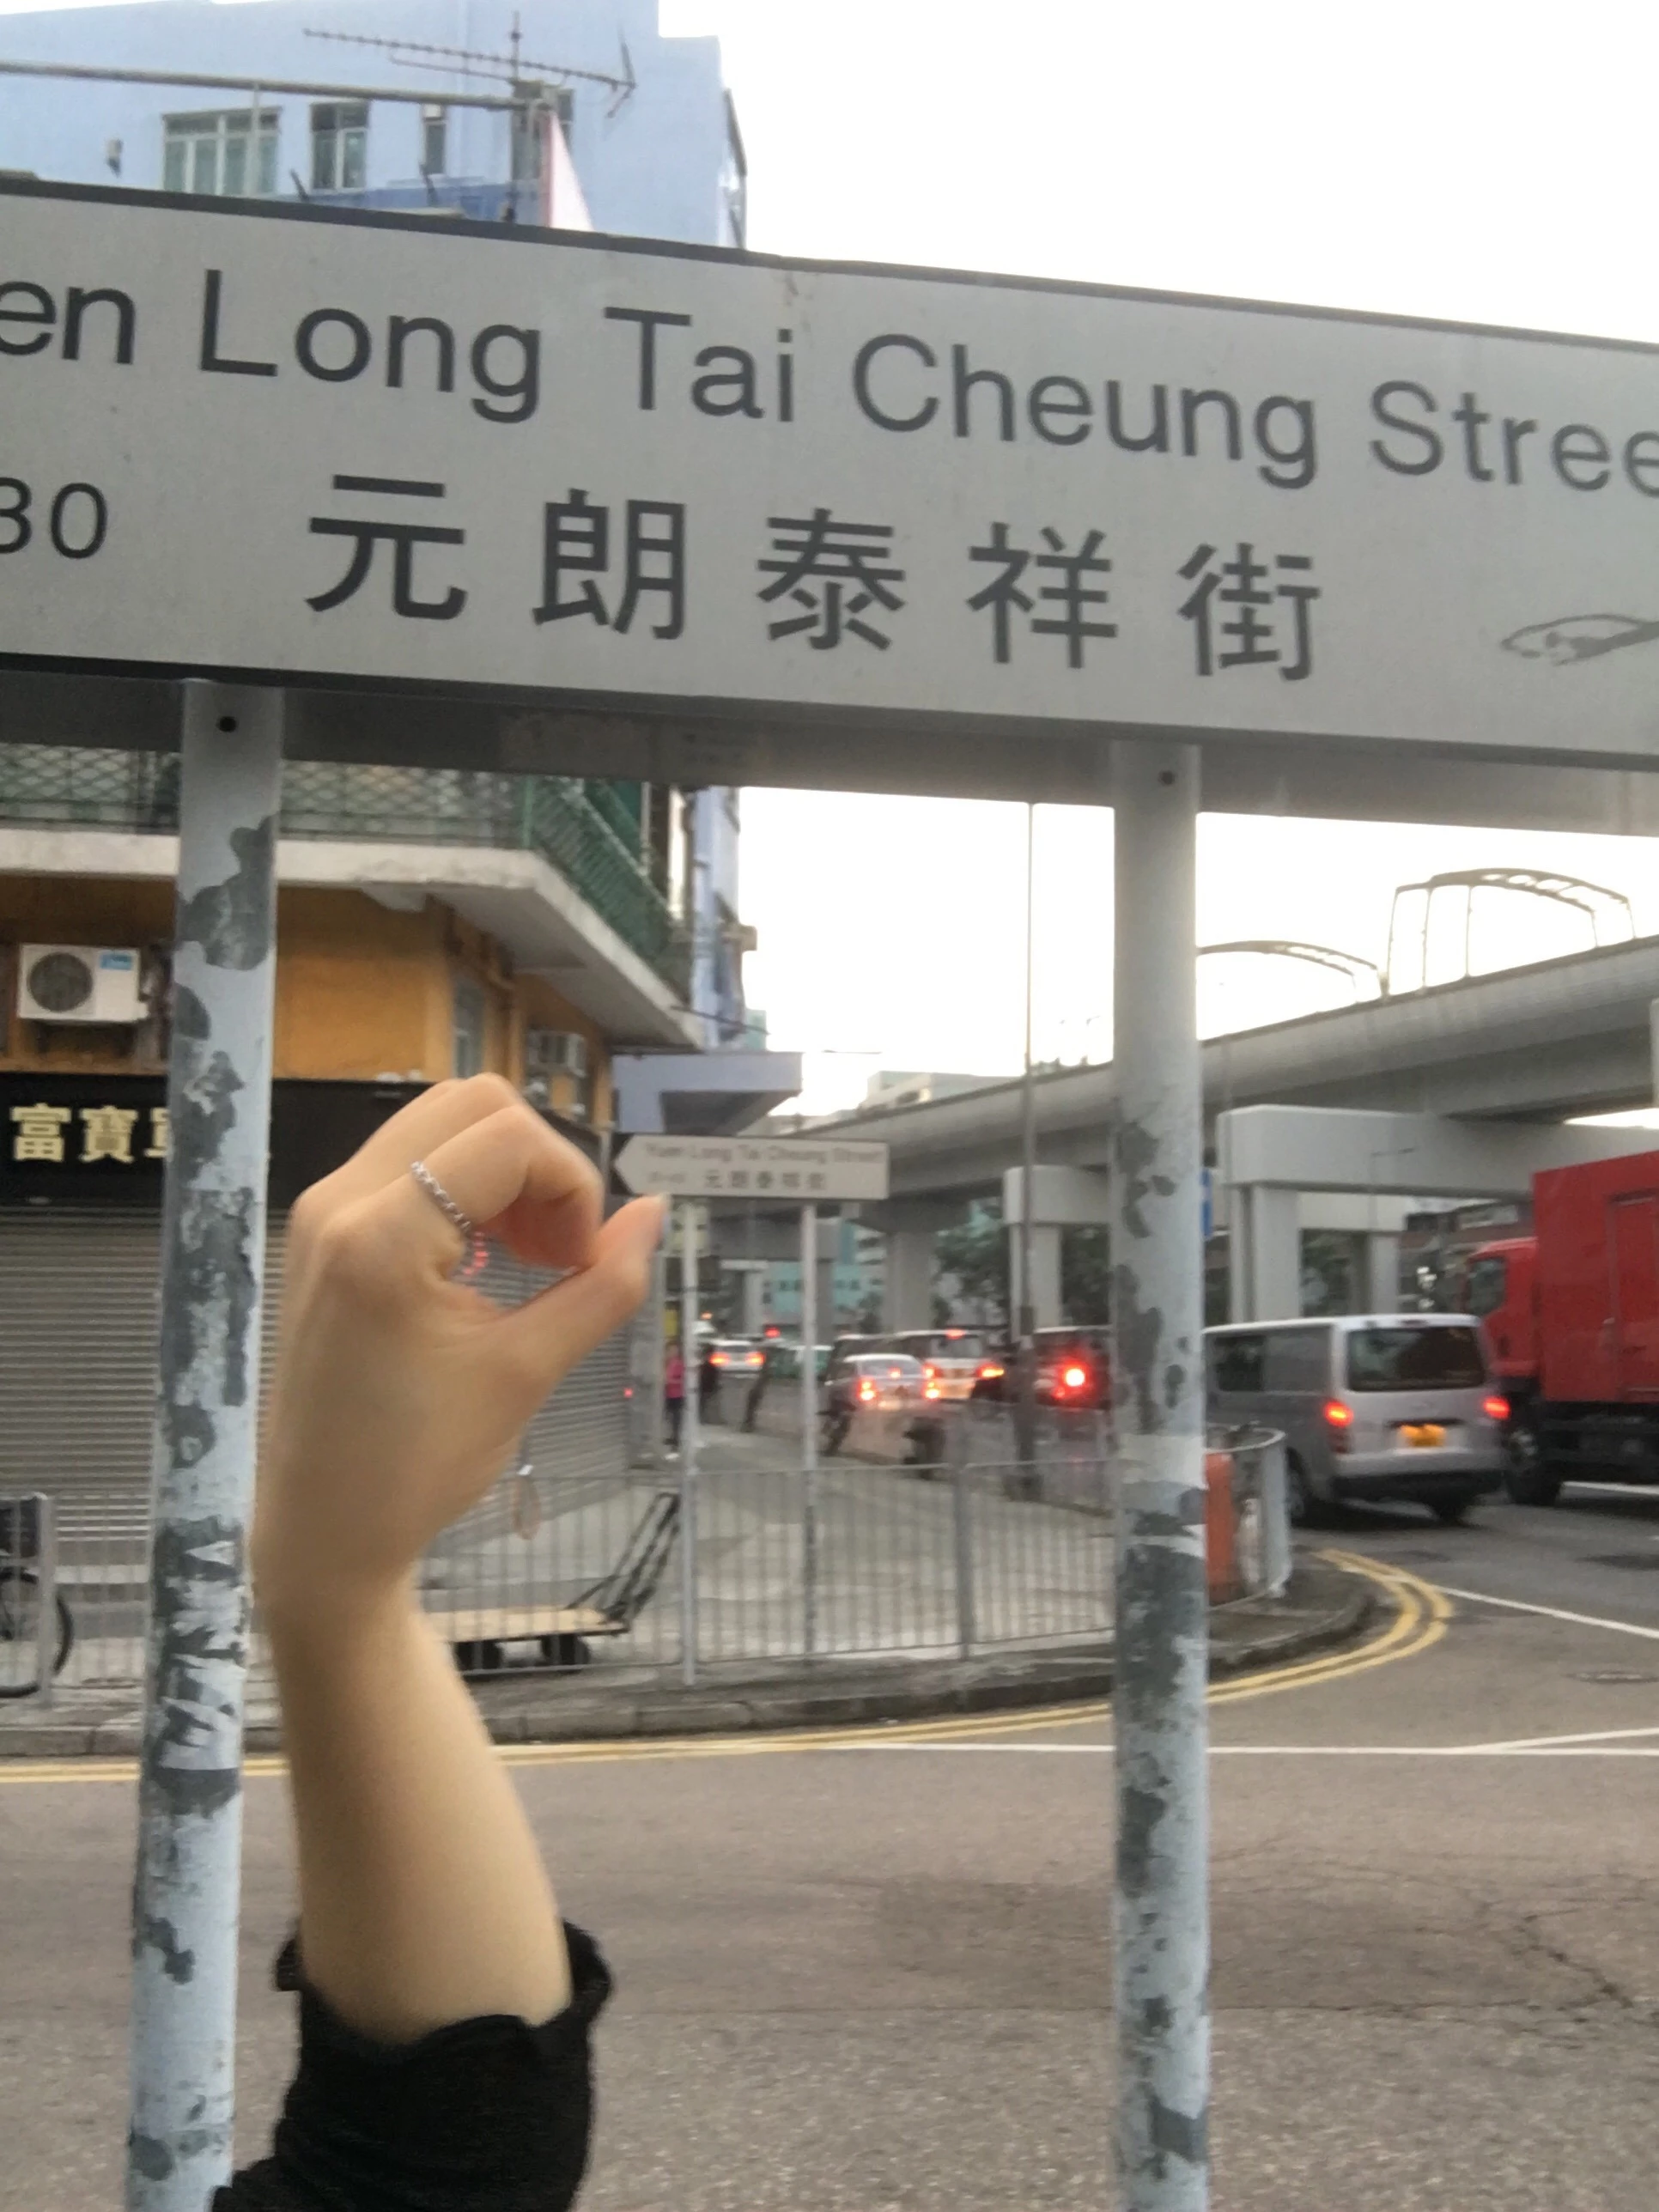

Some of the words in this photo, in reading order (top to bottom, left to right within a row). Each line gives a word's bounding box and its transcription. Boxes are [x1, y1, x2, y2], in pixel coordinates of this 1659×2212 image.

[199, 270, 540, 423] Long
[605, 307, 793, 422] Tai
[853, 334, 1316, 489] Cheung
[1370, 381, 1659, 498] Stree
[304, 474, 1321, 681] 元朗泰祥街
